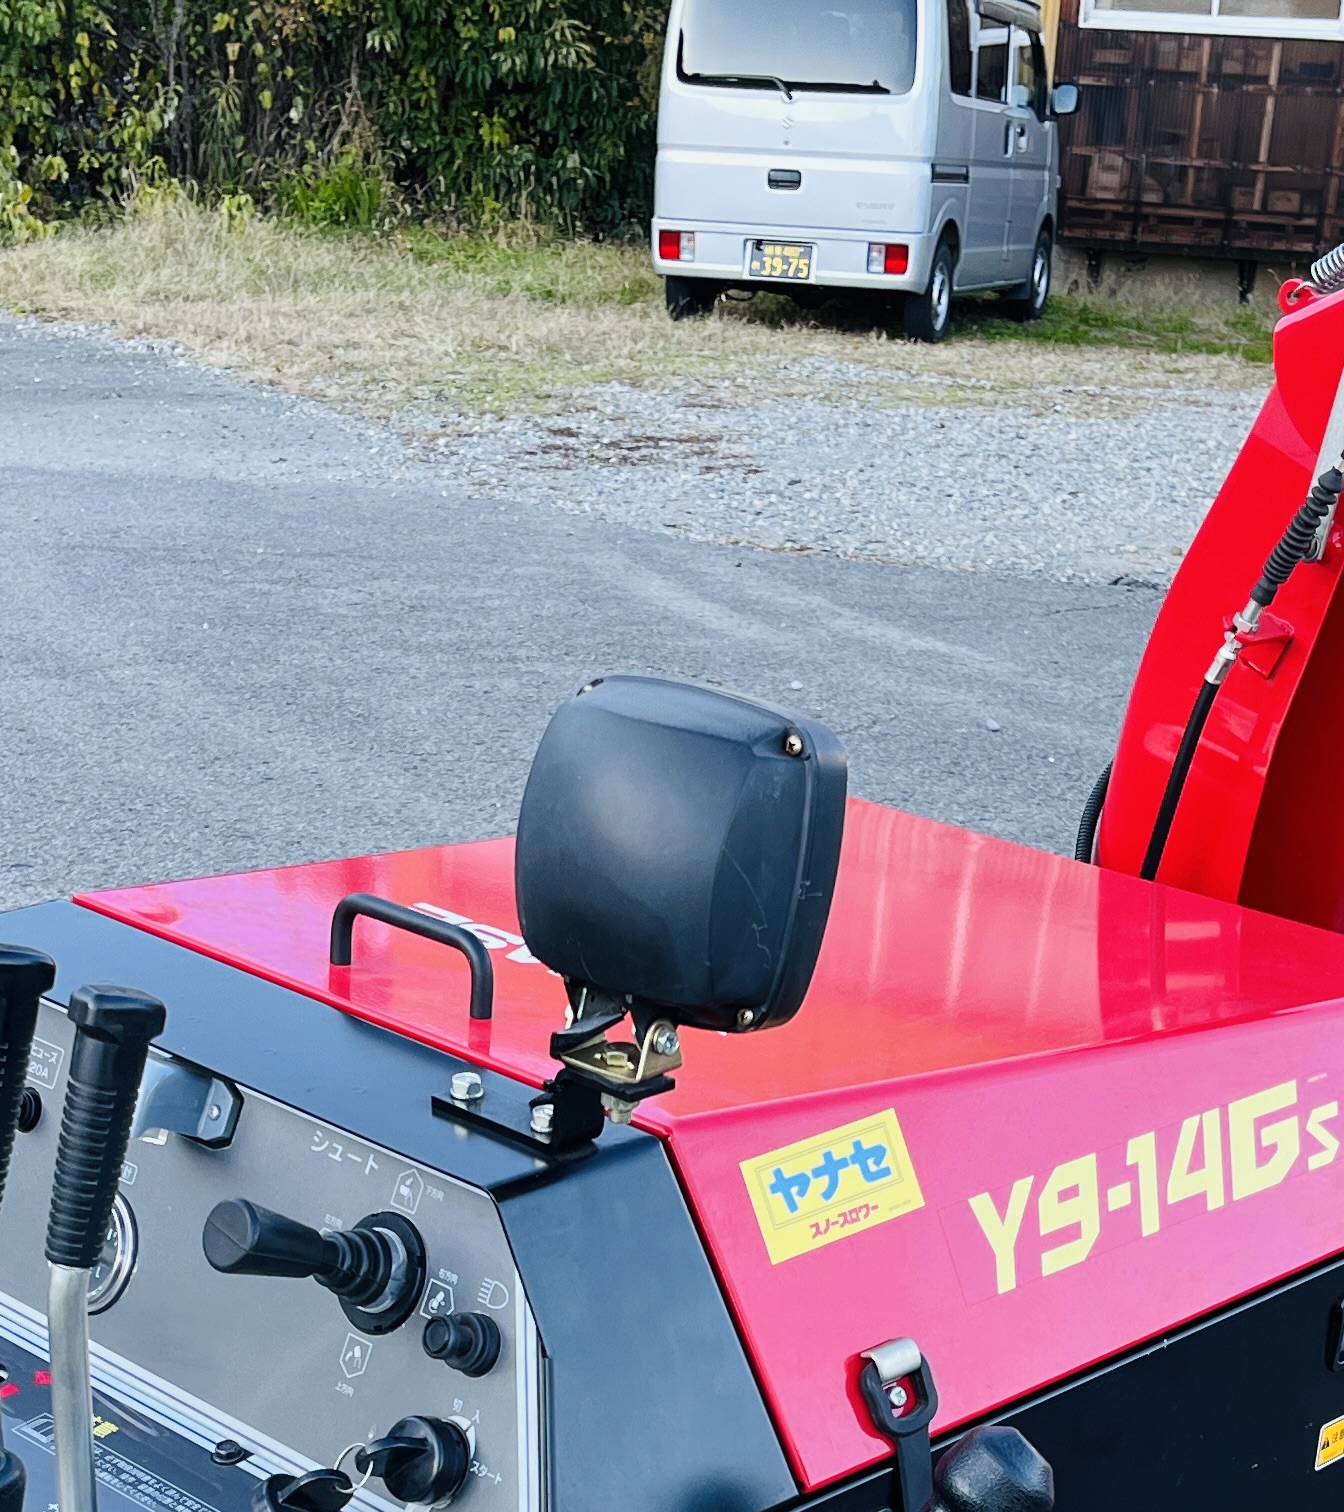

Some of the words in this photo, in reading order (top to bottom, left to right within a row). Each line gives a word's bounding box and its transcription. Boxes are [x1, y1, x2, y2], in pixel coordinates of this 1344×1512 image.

[761, 257, 809, 278] 39-75
[311, 1130, 379, 1175] シュート
[769, 1139, 892, 1214] ヤナセ
[470, 1460, 503, 1486] スタート
